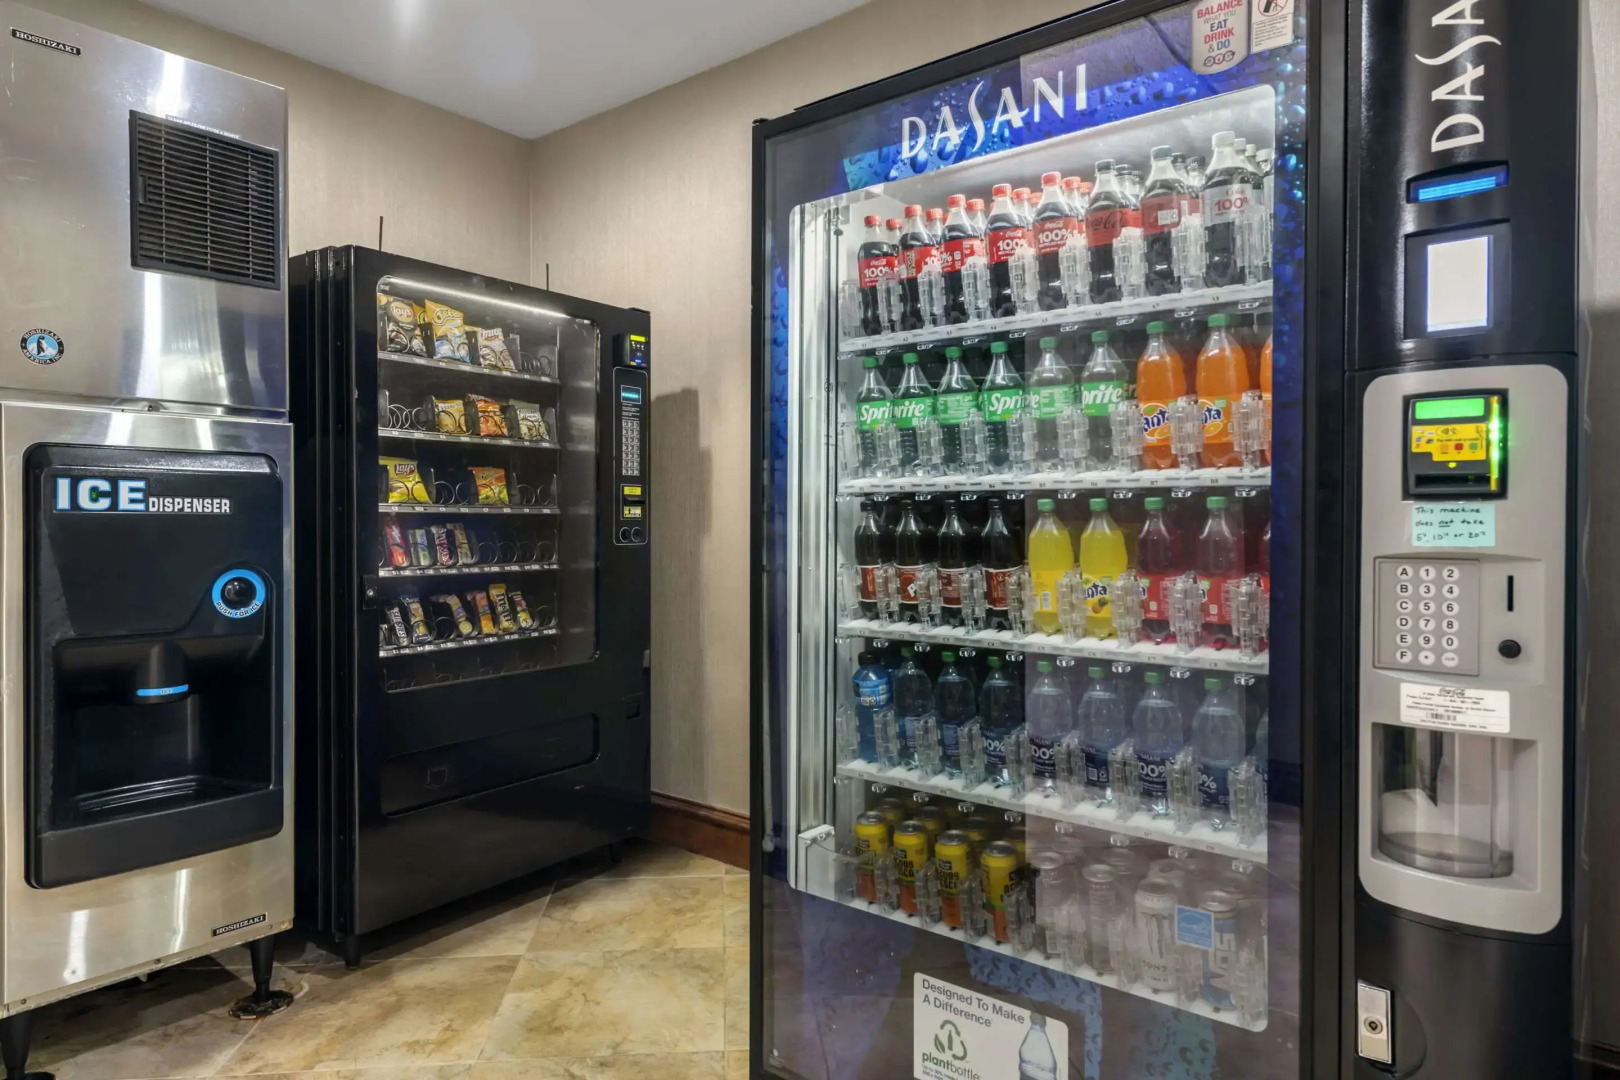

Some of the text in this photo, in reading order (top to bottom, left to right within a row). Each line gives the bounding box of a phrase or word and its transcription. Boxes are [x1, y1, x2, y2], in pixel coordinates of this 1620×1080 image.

[1197, 0, 1243, 19] BALANCE
[1210, 18, 1228, 32] EAT
[15, 30, 77, 54] HOSHIZAKI
[1204, 27, 1234, 44] DRINK
[1208, 38, 1230, 53] & DO
[902, 63, 1086, 159] DASANI
[1038, 228, 1071, 244] 100%
[1081, 384, 1122, 409] prite
[56, 477, 230, 513] ICE DISPENSER
[1414, 506, 1434, 515] This
[1415, 519, 1433, 527] does
[1438, 518, 1454, 528] not
[1400, 568, 1454, 578] A 1 2
[1400, 584, 1454, 595] B 3 4
[216, 601, 260, 617] PUSH FOR ICE
[1400, 601, 1454, 612] C 5 6
[1400, 617, 1454, 629] D 7 8
[1400, 634, 1454, 646] E 9 0
[1400, 651, 1408, 659] F
[216, 915, 264, 935] HOSHIZAKI
[922, 978, 1025, 1024] Designed To Make
[922, 994, 992, 1027] A Difference
[922, 1051, 980, 1080] plantbottle
